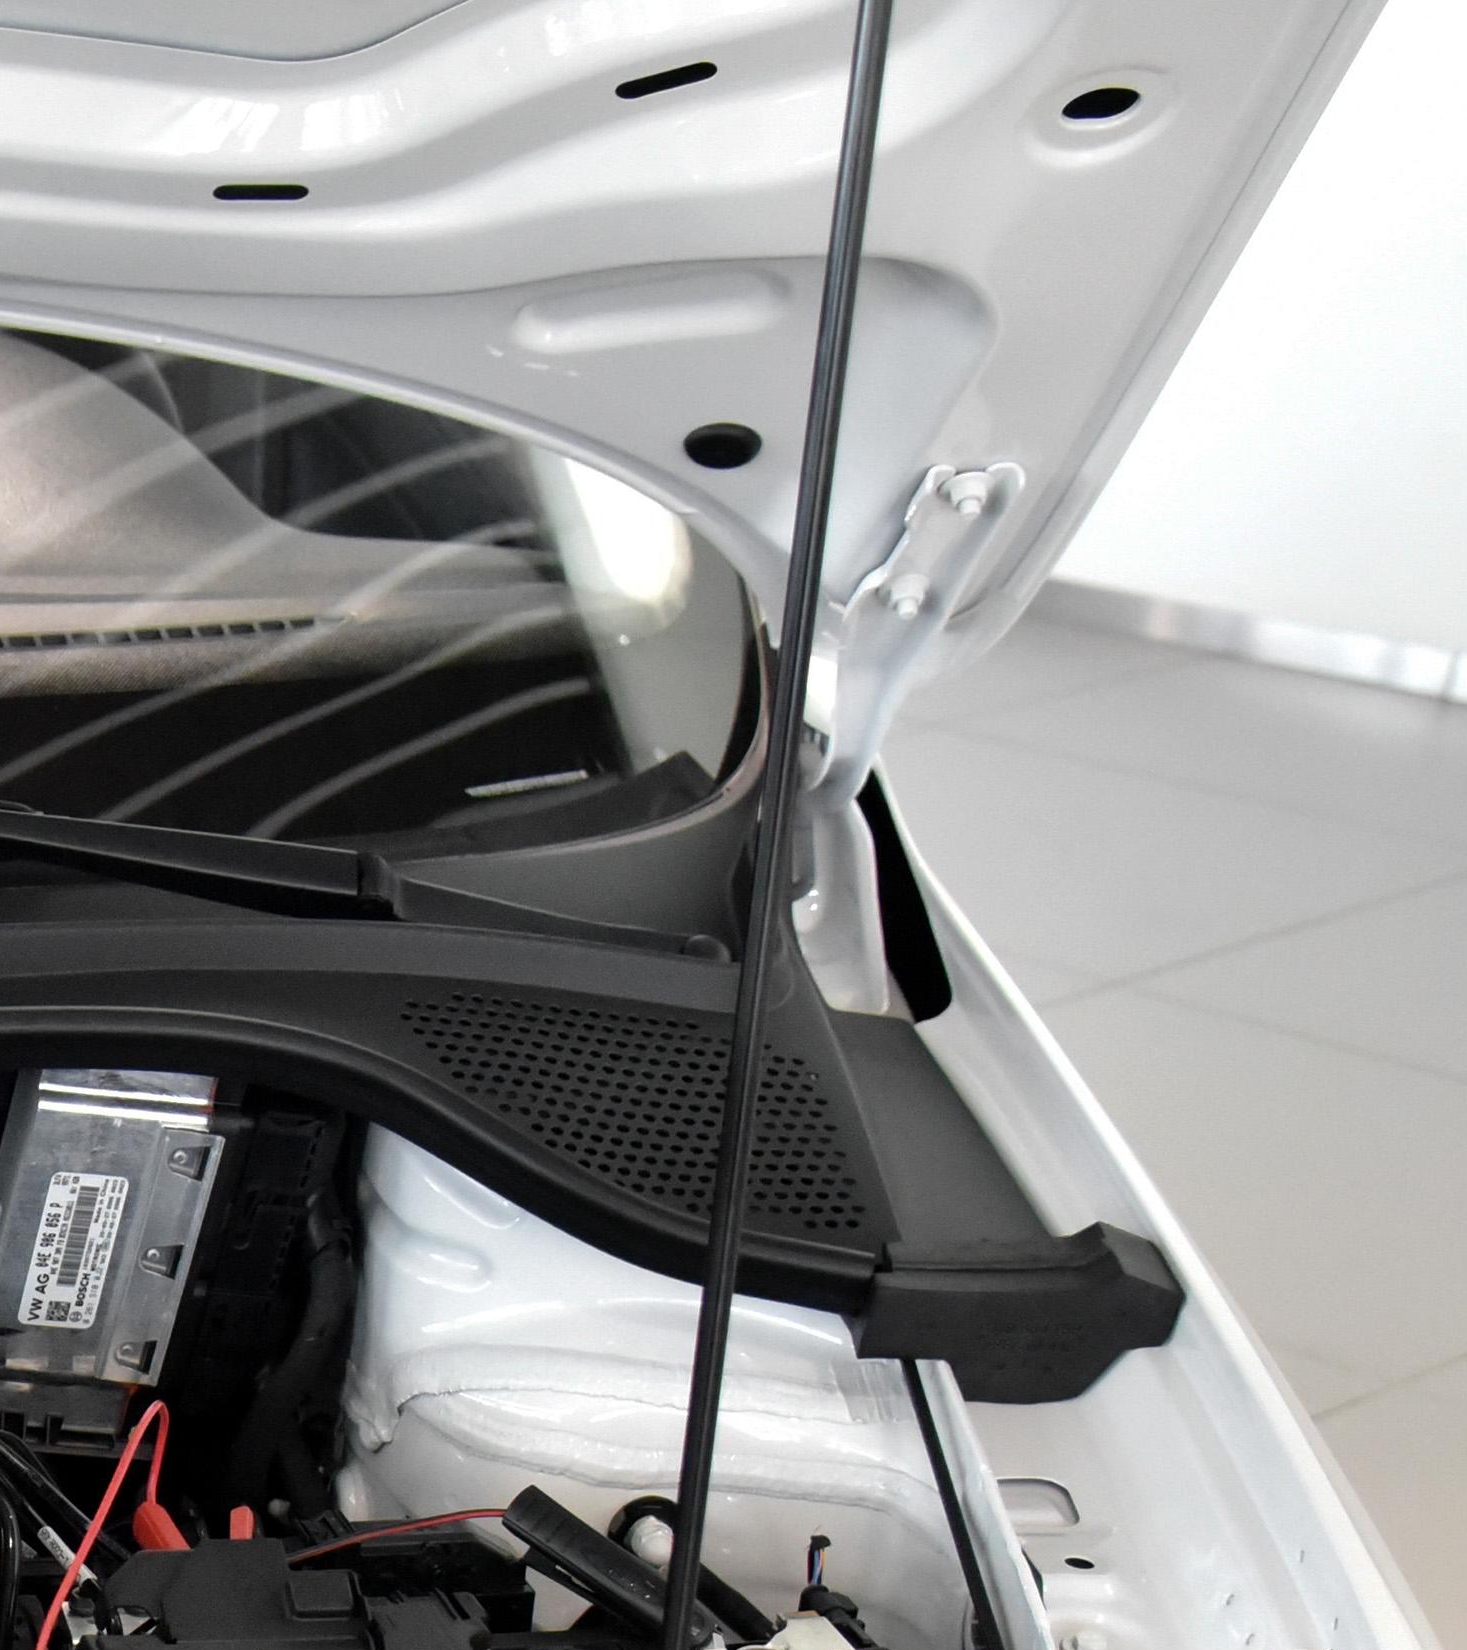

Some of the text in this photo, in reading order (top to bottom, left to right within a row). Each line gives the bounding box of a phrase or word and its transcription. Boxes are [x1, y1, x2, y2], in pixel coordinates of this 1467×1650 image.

[26, 1272, 51, 1322] VW AG
[73, 1272, 92, 1308] BOSCH
